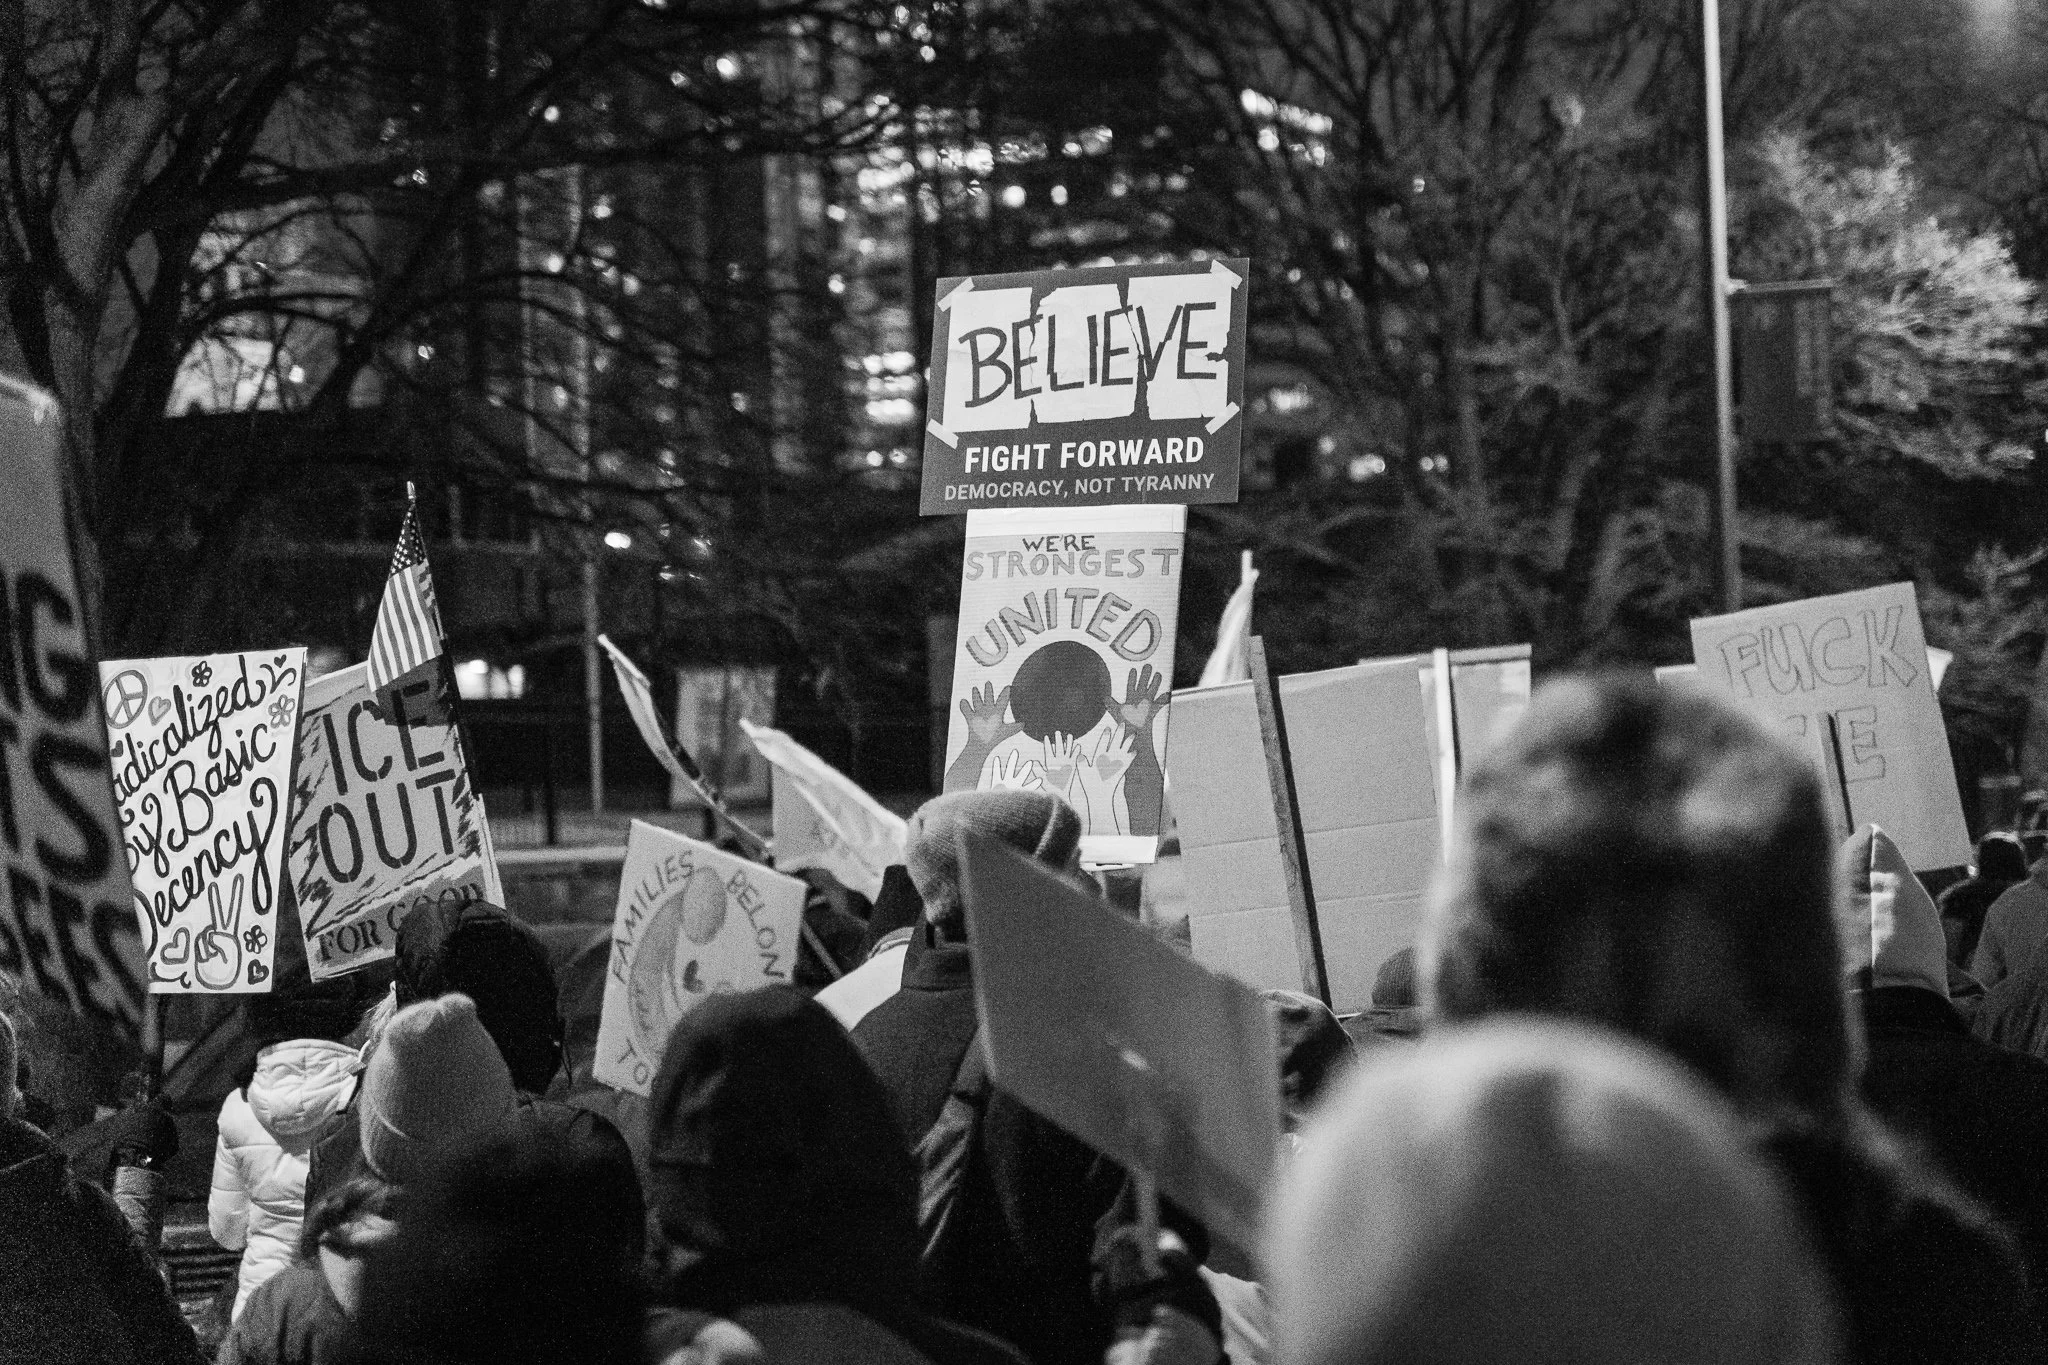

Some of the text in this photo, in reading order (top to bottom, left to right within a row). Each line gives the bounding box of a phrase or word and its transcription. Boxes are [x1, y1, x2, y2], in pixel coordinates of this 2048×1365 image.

[958, 301, 1217, 408] BELIEVE
[944, 473, 1215, 501] DEMOCRACY, NOT TYRANNY
[964, 436, 1205, 474] FIGHT FORWARD
[965, 548, 1179, 581] STRONGEST
[1022, 534, 1096, 552] WE'RE
[965, 587, 1163, 667] UNITED
[1715, 604, 1919, 698] FUCK
[113, 654, 267, 809] adicalized
[322, 680, 446, 797] ICE
[162, 723, 276, 853] Basic
[318, 769, 457, 883] OUT
[316, 918, 383, 963] FOR
[612, 849, 695, 985] FAMILIES
